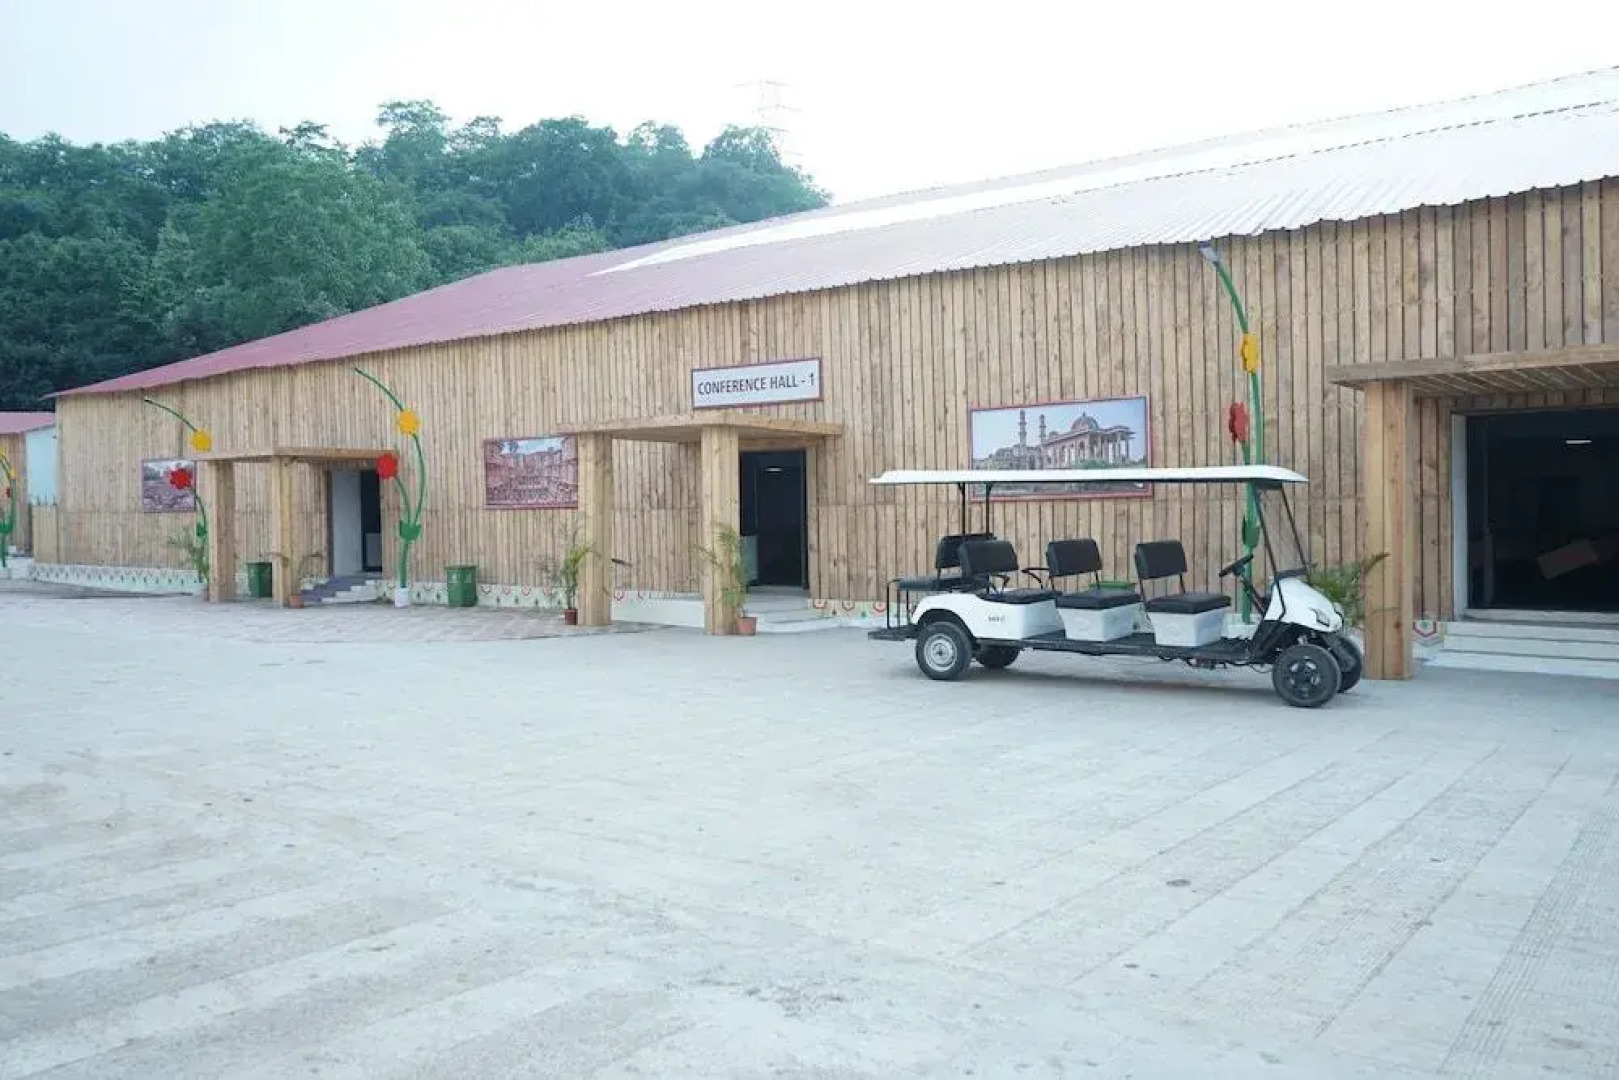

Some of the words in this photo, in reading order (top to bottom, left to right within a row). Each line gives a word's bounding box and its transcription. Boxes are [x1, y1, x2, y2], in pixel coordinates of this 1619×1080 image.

[698, 377, 767, 395] CONFERENCE
[770, 375, 798, 389] HALL
[809, 373, 815, 386] 1
